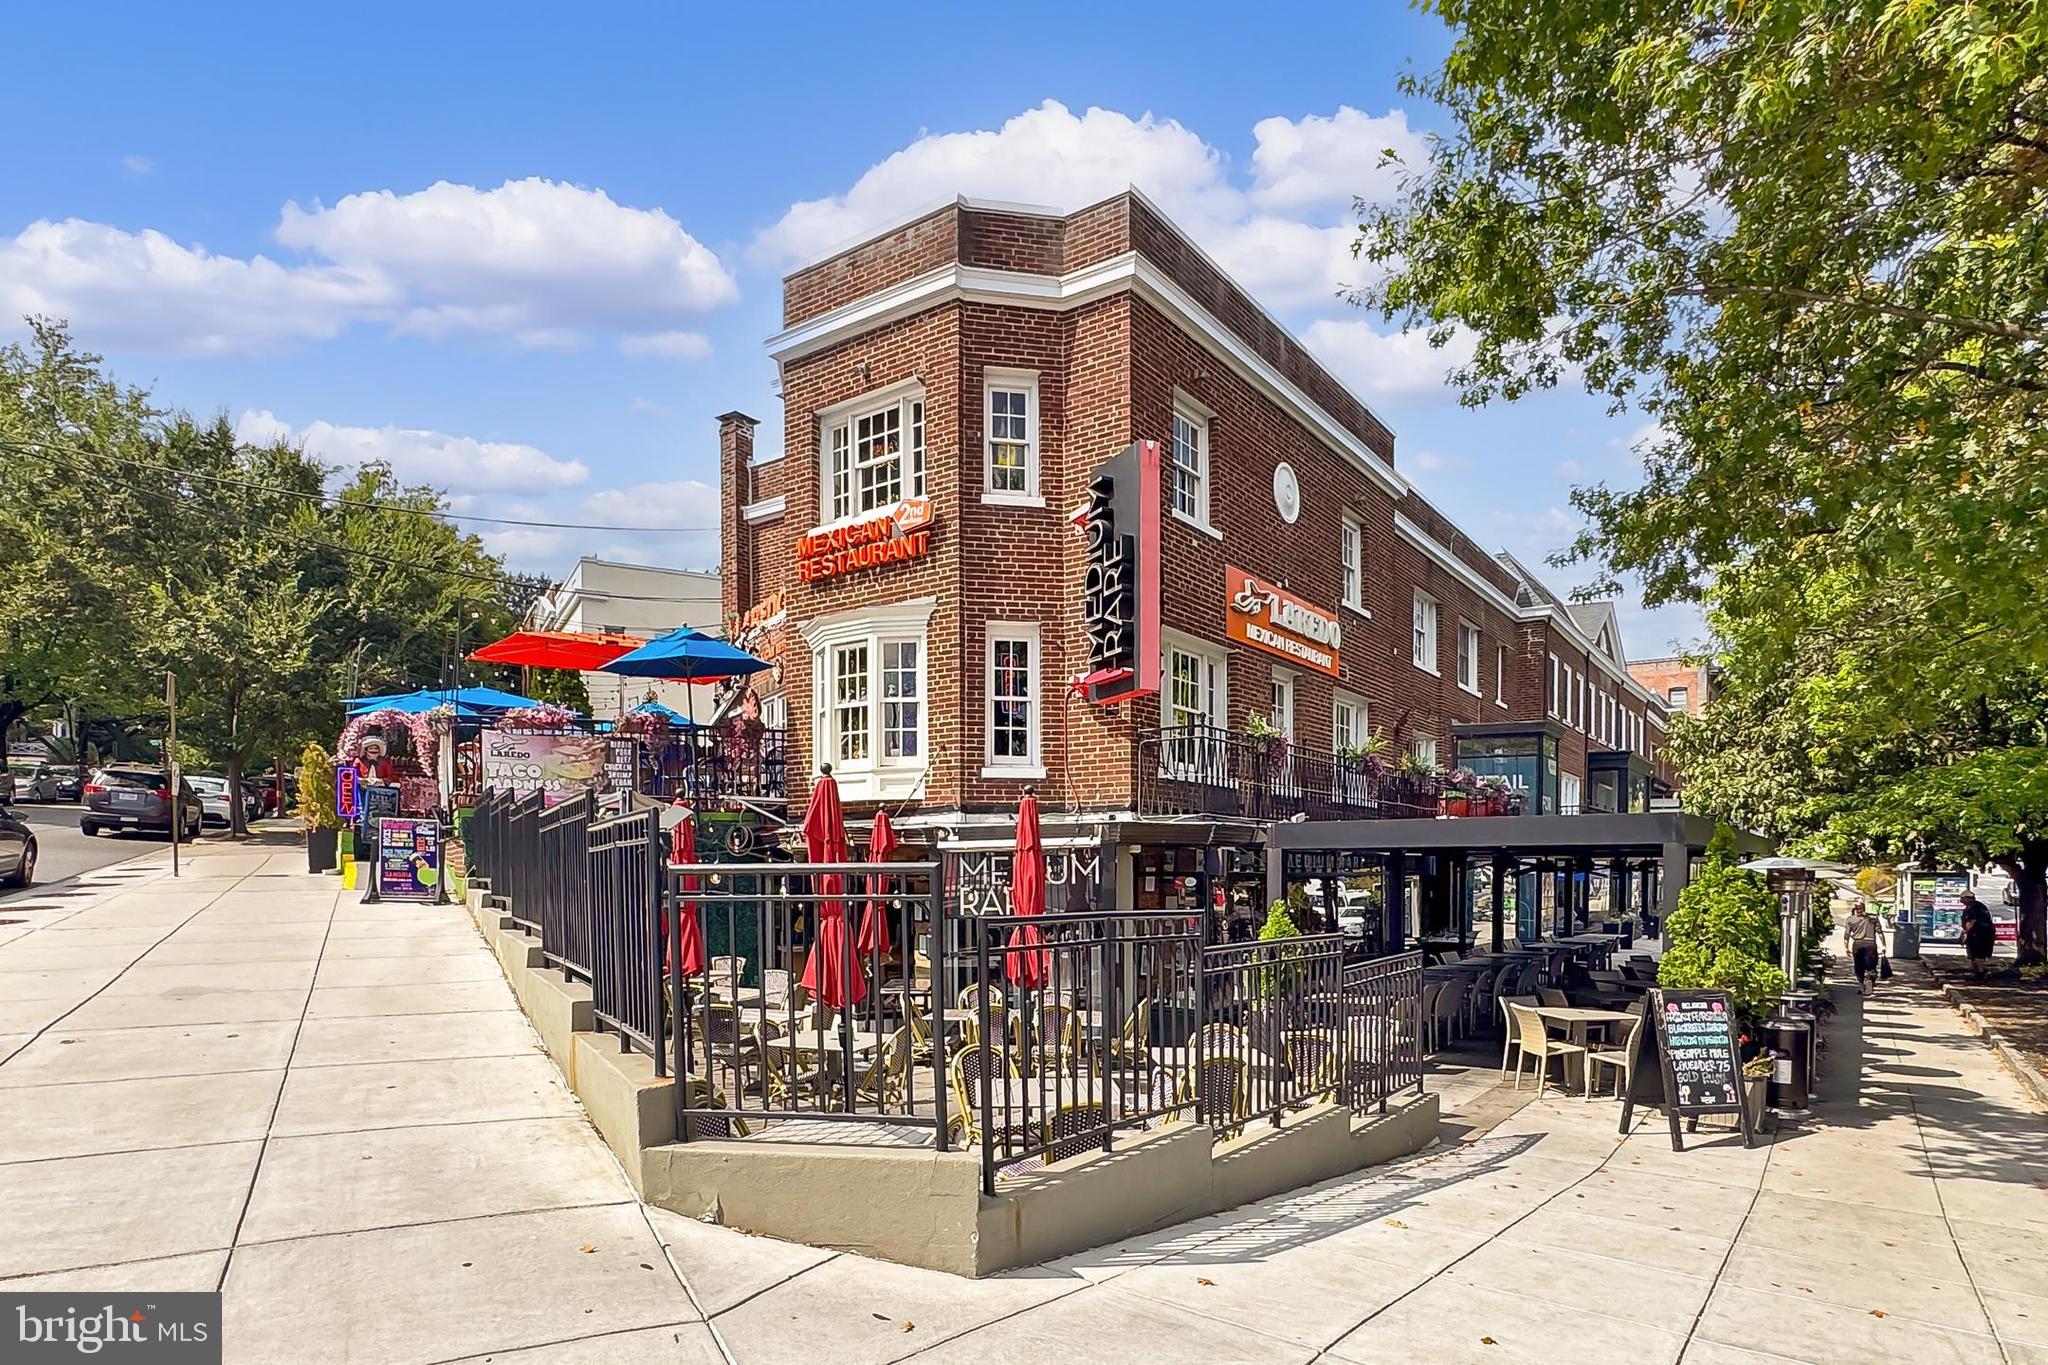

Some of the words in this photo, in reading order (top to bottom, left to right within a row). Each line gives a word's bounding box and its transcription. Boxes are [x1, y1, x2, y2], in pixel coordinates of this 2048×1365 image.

[899, 502, 924, 524] 2nd
[797, 516, 893, 561] MEXICAN
[798, 530, 931, 583] RESTAURANT
[1085, 475, 1107, 664] MEDIUM
[1102, 537, 1125, 659] RARE
[1269, 592, 1341, 650] LAREDO
[1246, 622, 1285, 651] MEXICAN
[1285, 638, 1333, 669] RESTAURANT
[490, 749, 531, 759] LAREDO
[486, 761, 542, 779] TACO
[603, 763, 632, 772] CHICKEN
[486, 777, 561, 792] MADNESS
[959, 854, 1100, 886] MEUM
[1670, 1048, 1708, 1060] PINEAPPLE
[1672, 1060, 1717, 1072] LAVENDER
[1716, 1060, 1731, 1073] 75
[1676, 1071, 1699, 1084] GOLD
